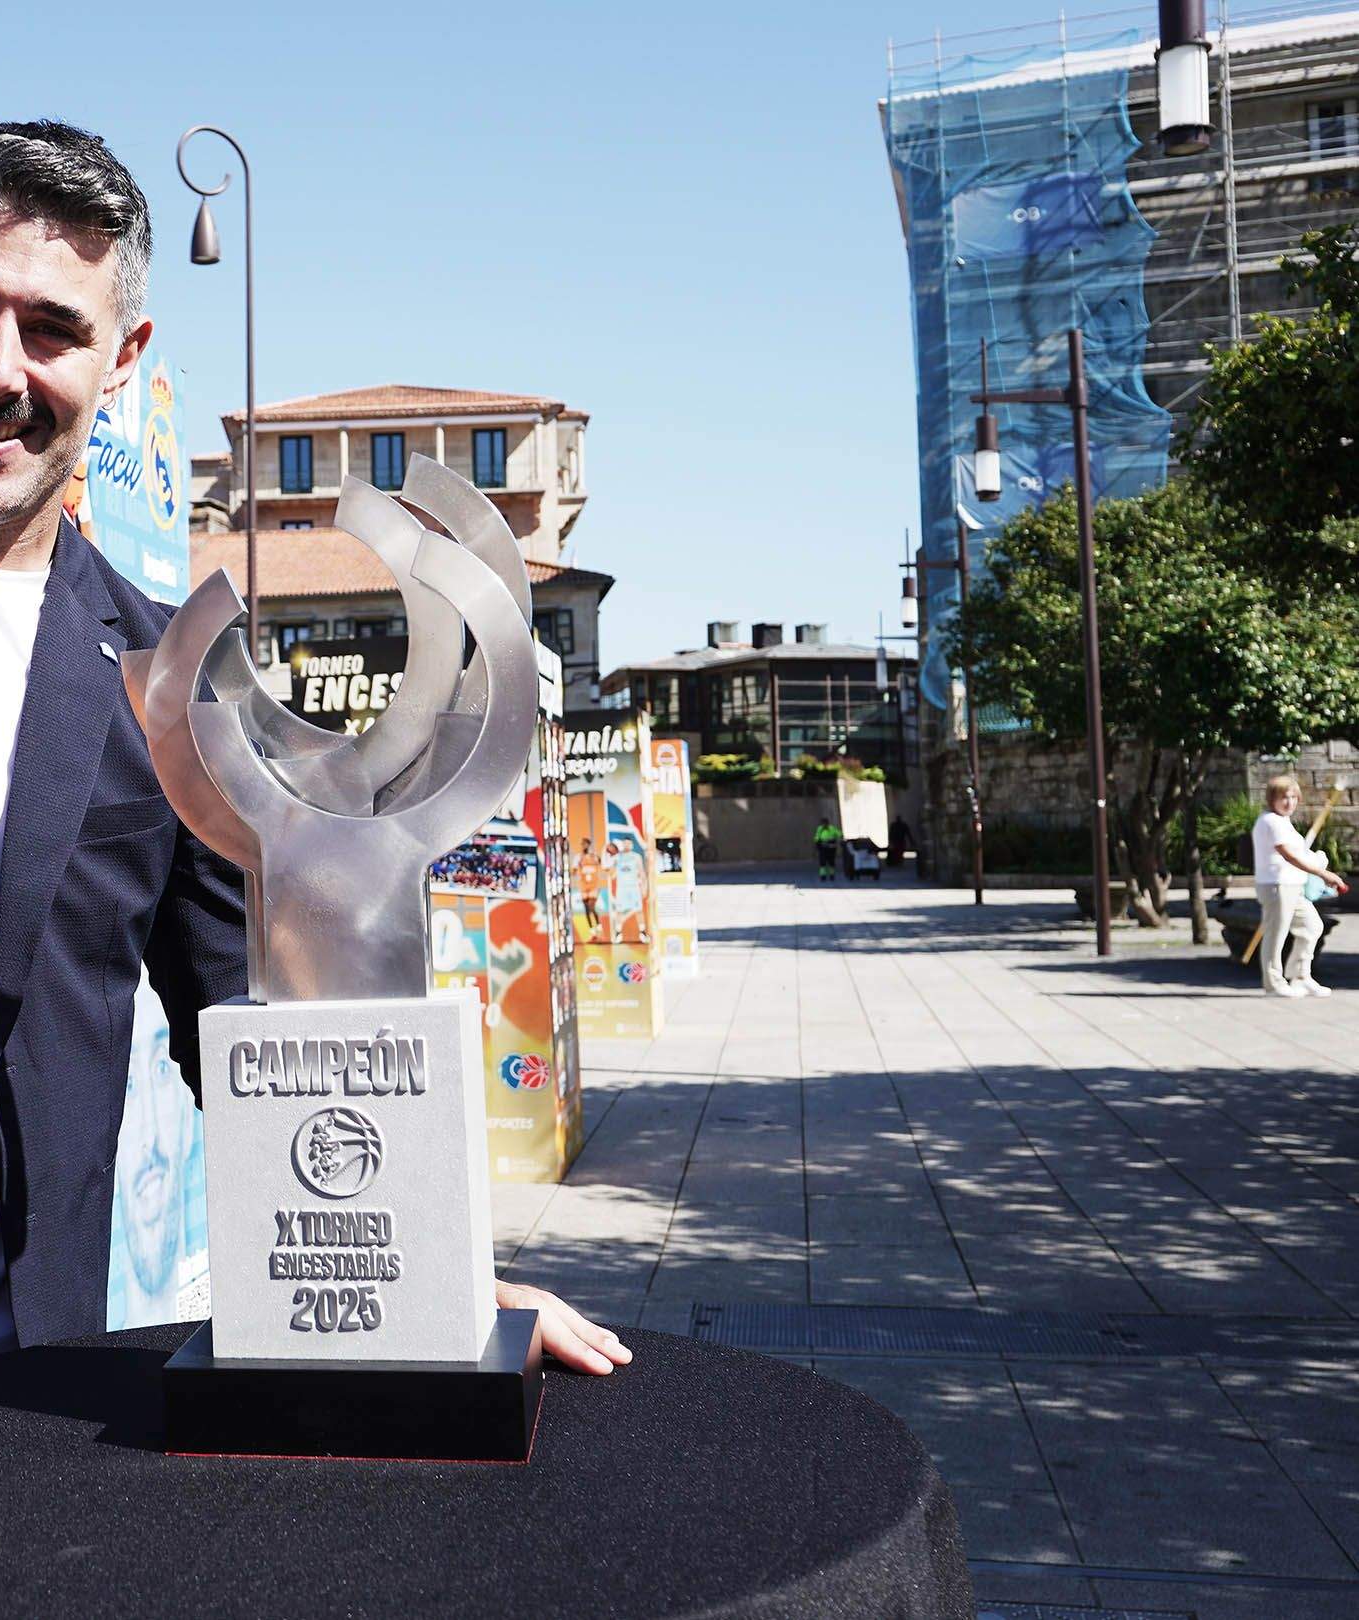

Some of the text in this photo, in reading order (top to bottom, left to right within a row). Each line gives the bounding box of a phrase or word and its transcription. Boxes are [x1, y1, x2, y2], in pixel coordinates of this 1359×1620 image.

[300, 654, 364, 677] TORNEO
[229, 1027, 427, 1098] CAMPEÓN
[274, 1210, 393, 1247] X TORNEO
[269, 1246, 402, 1281] ENCESTARÍAS
[290, 1285, 382, 1333] 2025
